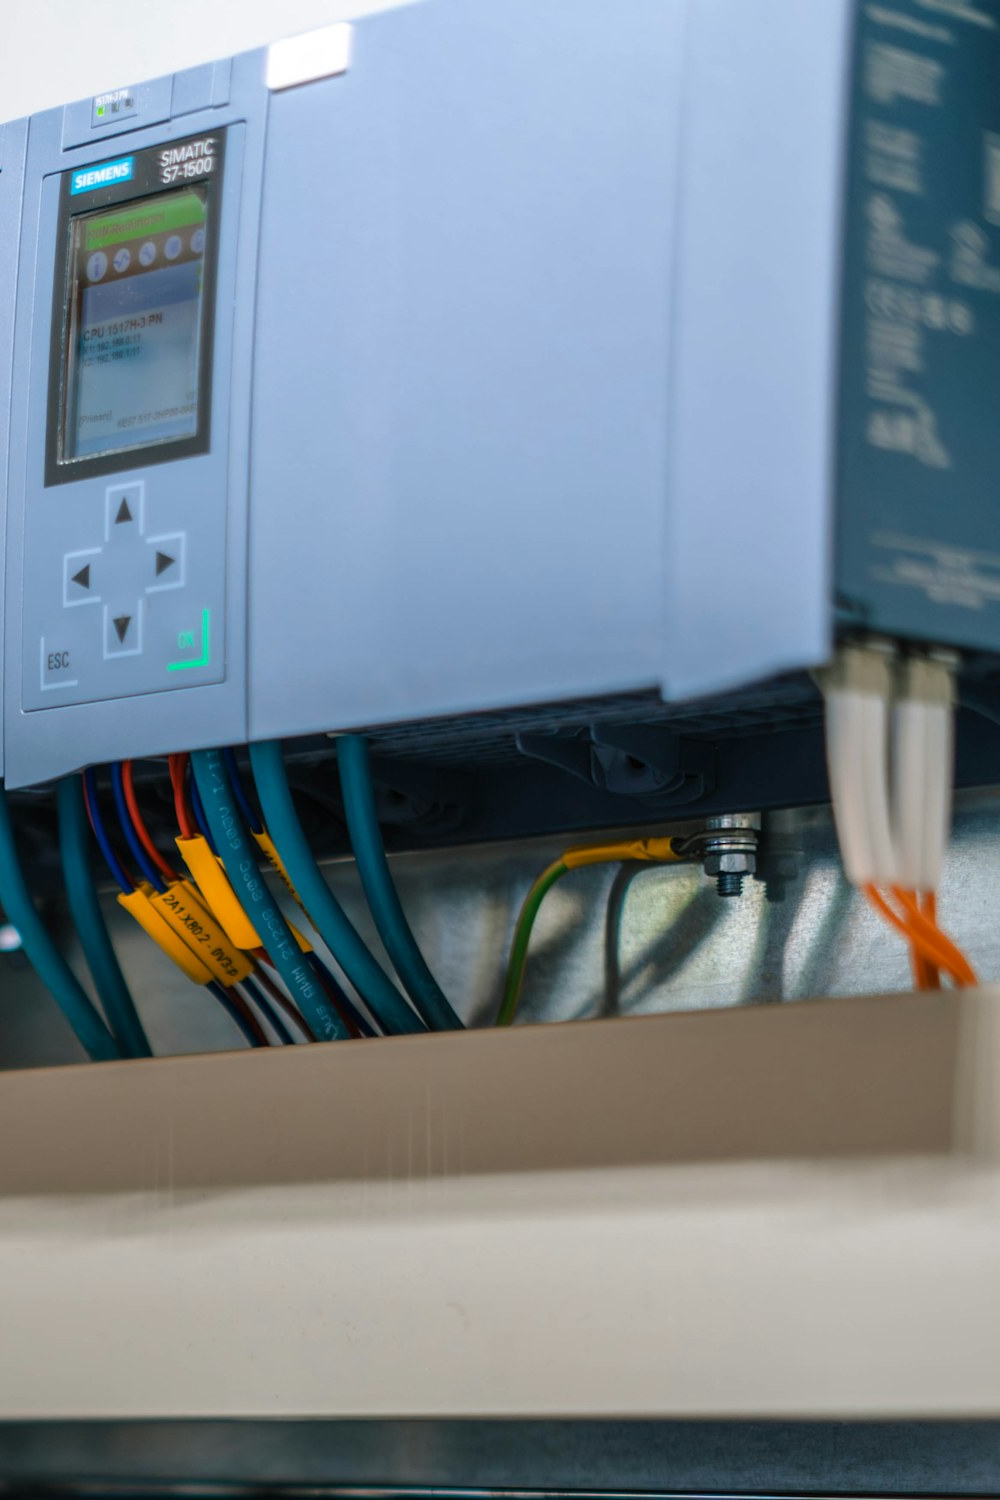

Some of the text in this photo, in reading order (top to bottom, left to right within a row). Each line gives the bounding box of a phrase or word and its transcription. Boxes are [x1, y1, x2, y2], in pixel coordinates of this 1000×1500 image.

[160, 139, 213, 167] SIMATIC
[74, 161, 131, 189] SIEMENS
[161, 158, 212, 184] S7-1500
[148, 312, 164, 328] PN
[177, 629, 196, 649] OK
[47, 651, 70, 671] ESC
